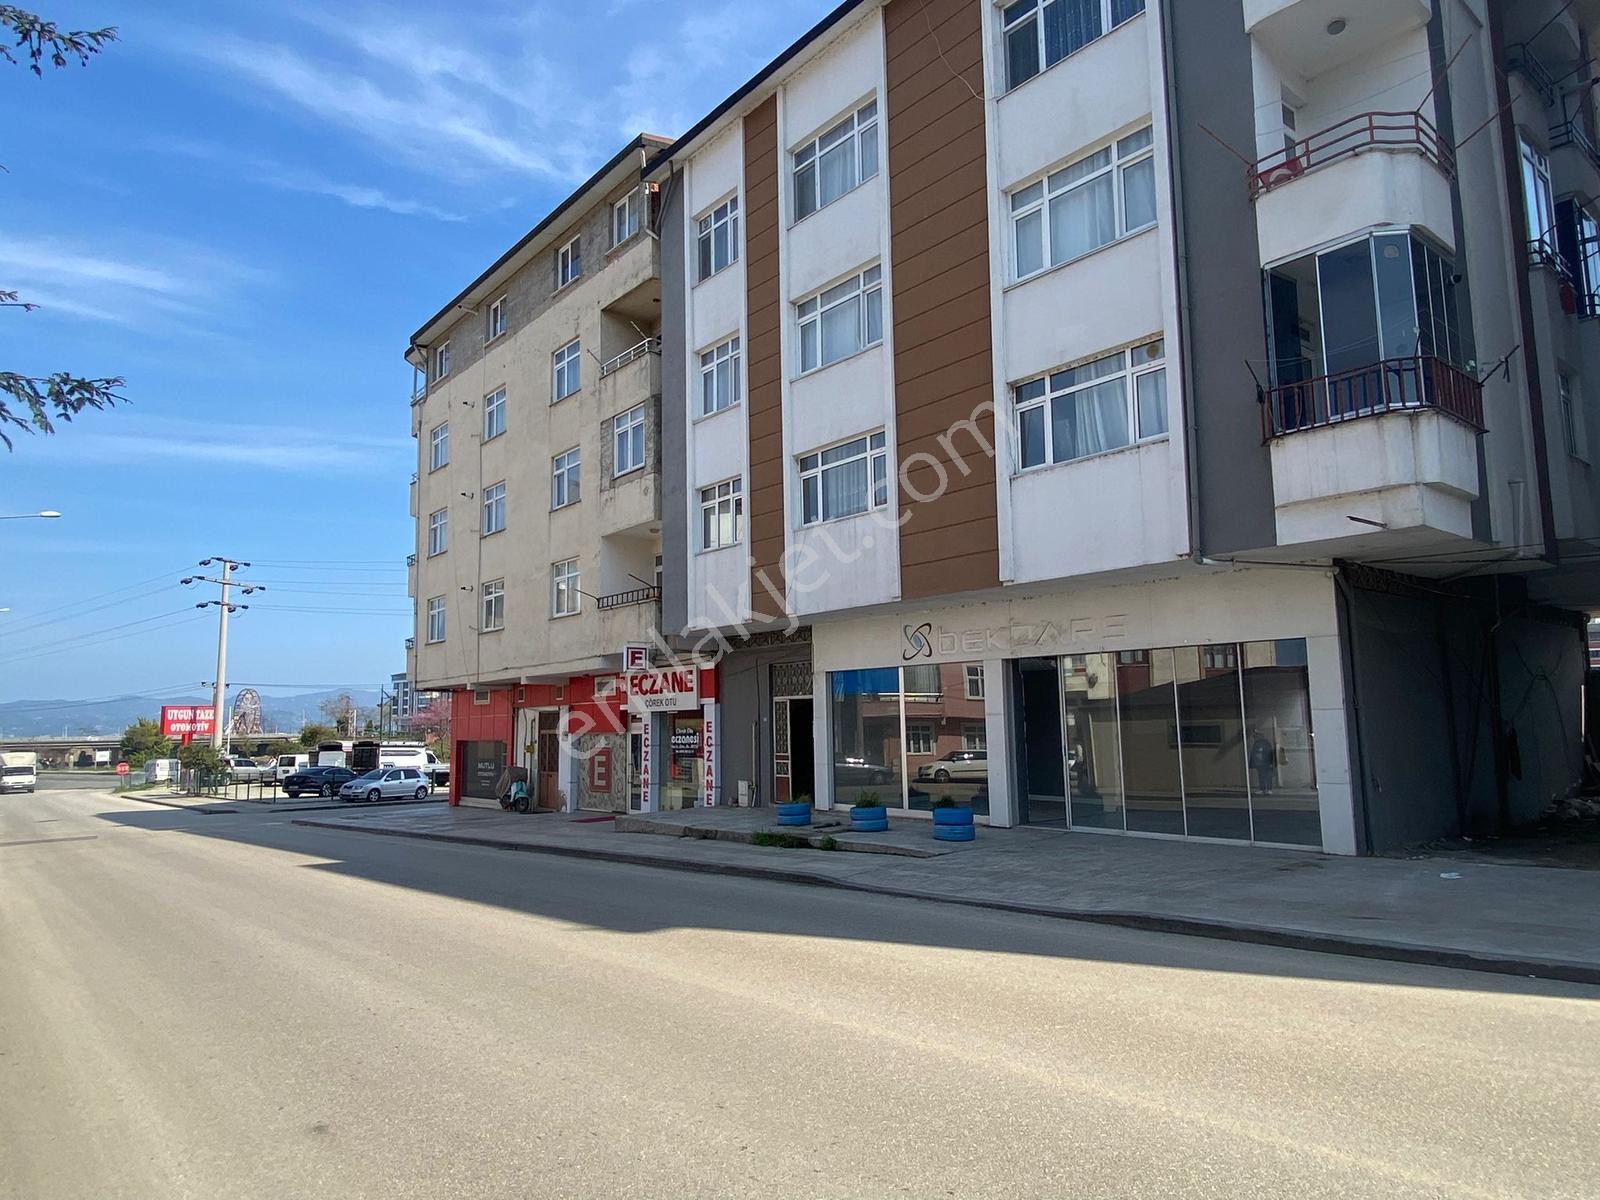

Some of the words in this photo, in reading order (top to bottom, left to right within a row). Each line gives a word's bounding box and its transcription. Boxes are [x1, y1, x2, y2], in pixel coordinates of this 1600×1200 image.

[630, 651, 643, 667] E
[630, 669, 694, 696] ECZANE
[665, 697, 677, 707] OTU
[167, 709, 194, 721] UYGUN
[671, 732, 700, 744] eczanesi
[594, 755, 607, 787] E
